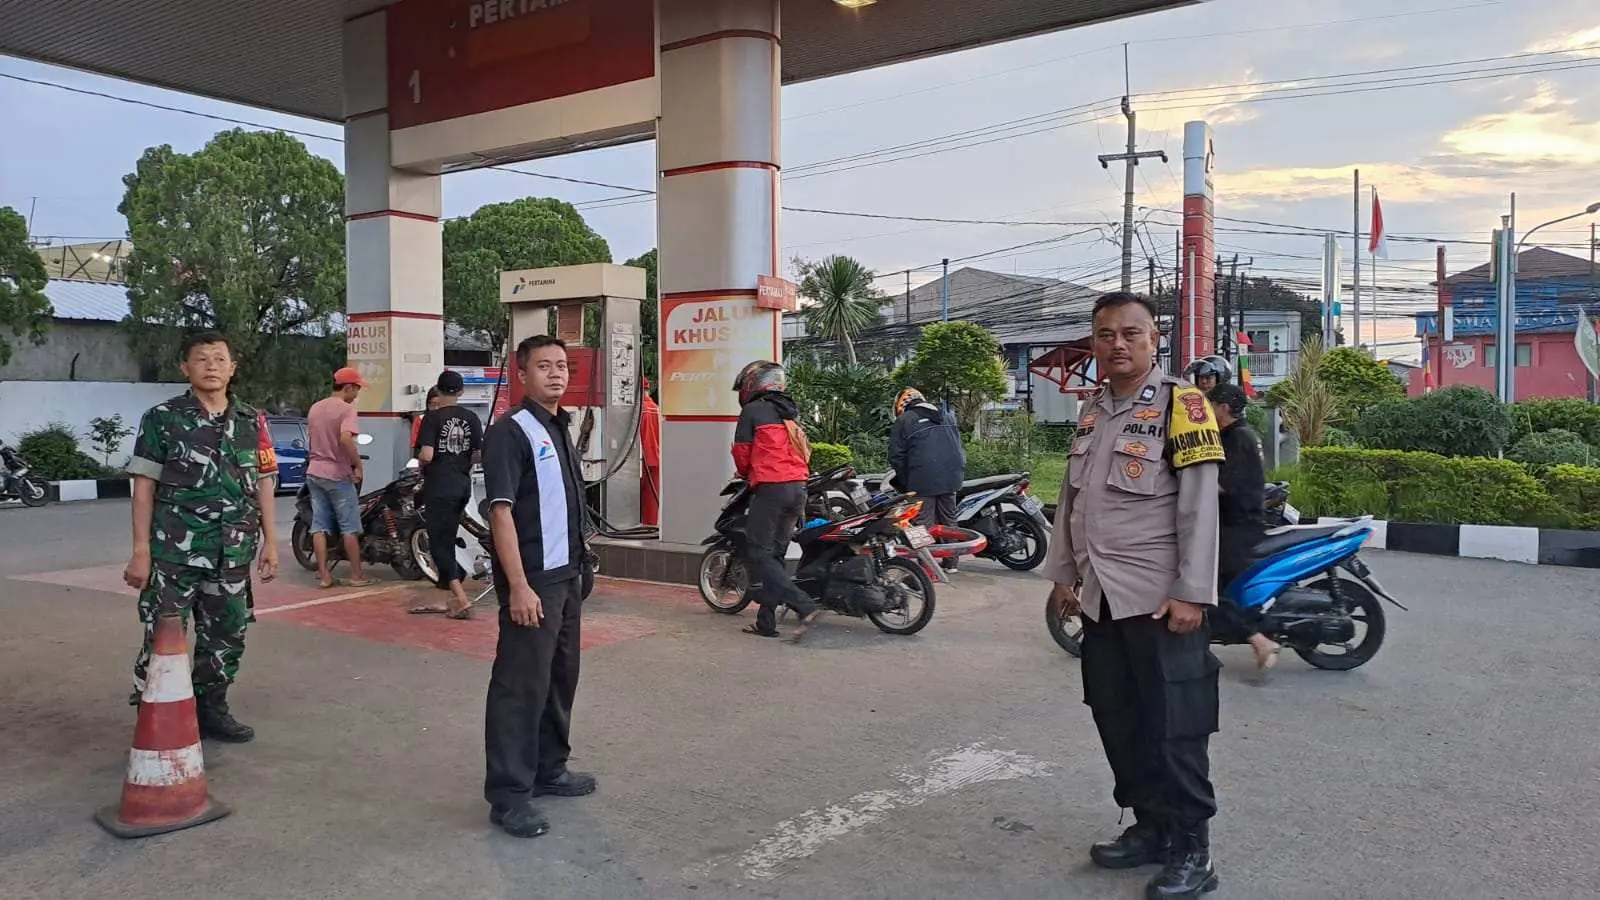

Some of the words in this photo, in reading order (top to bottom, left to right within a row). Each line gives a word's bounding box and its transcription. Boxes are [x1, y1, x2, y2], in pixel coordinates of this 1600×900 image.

[408, 69, 422, 103] 1
[348, 326, 386, 338] JALUR
[1123, 423, 1163, 438] POLRI
